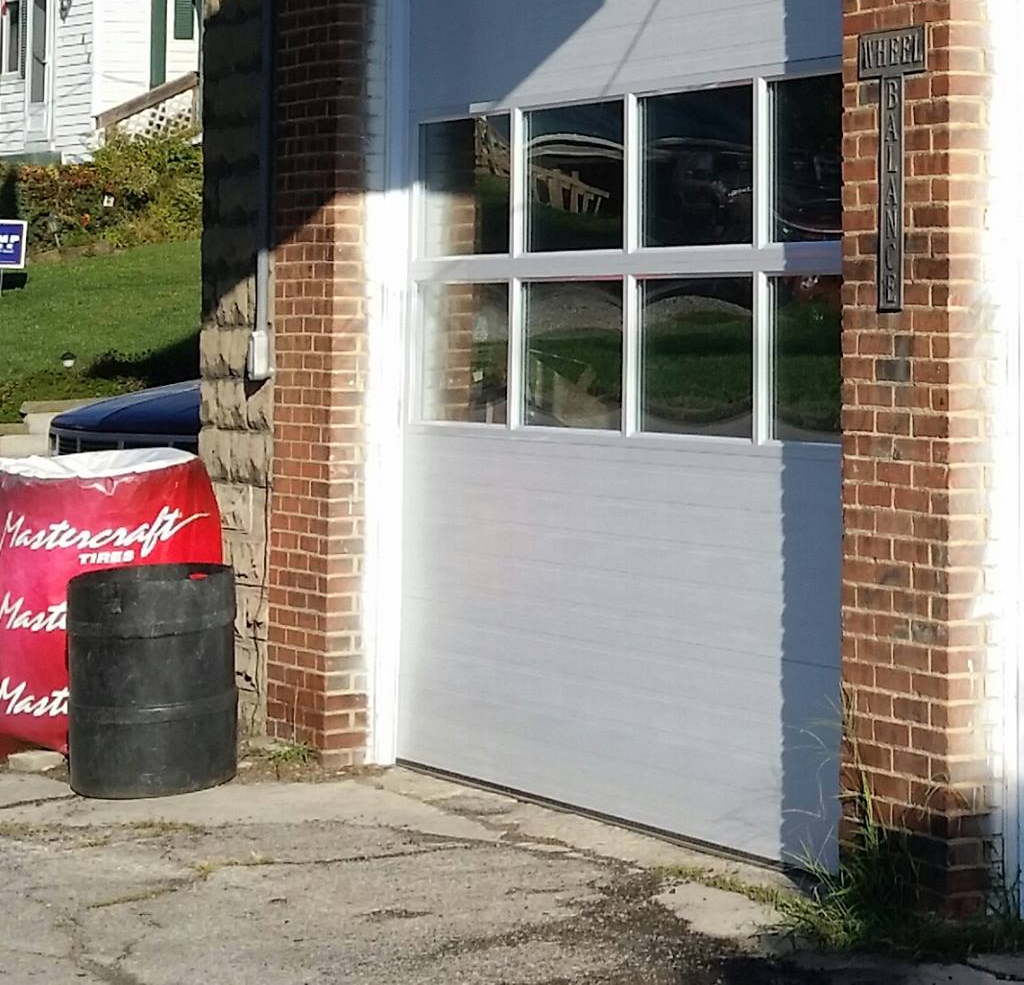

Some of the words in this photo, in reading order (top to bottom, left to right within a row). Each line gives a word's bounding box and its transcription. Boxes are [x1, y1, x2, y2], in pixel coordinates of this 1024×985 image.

[862, 33, 924, 70] WHEEL
[883, 80, 898, 304] BALANCE
[1, 505, 211, 557] Mastercraft
[79, 550, 135, 564] TIRES
